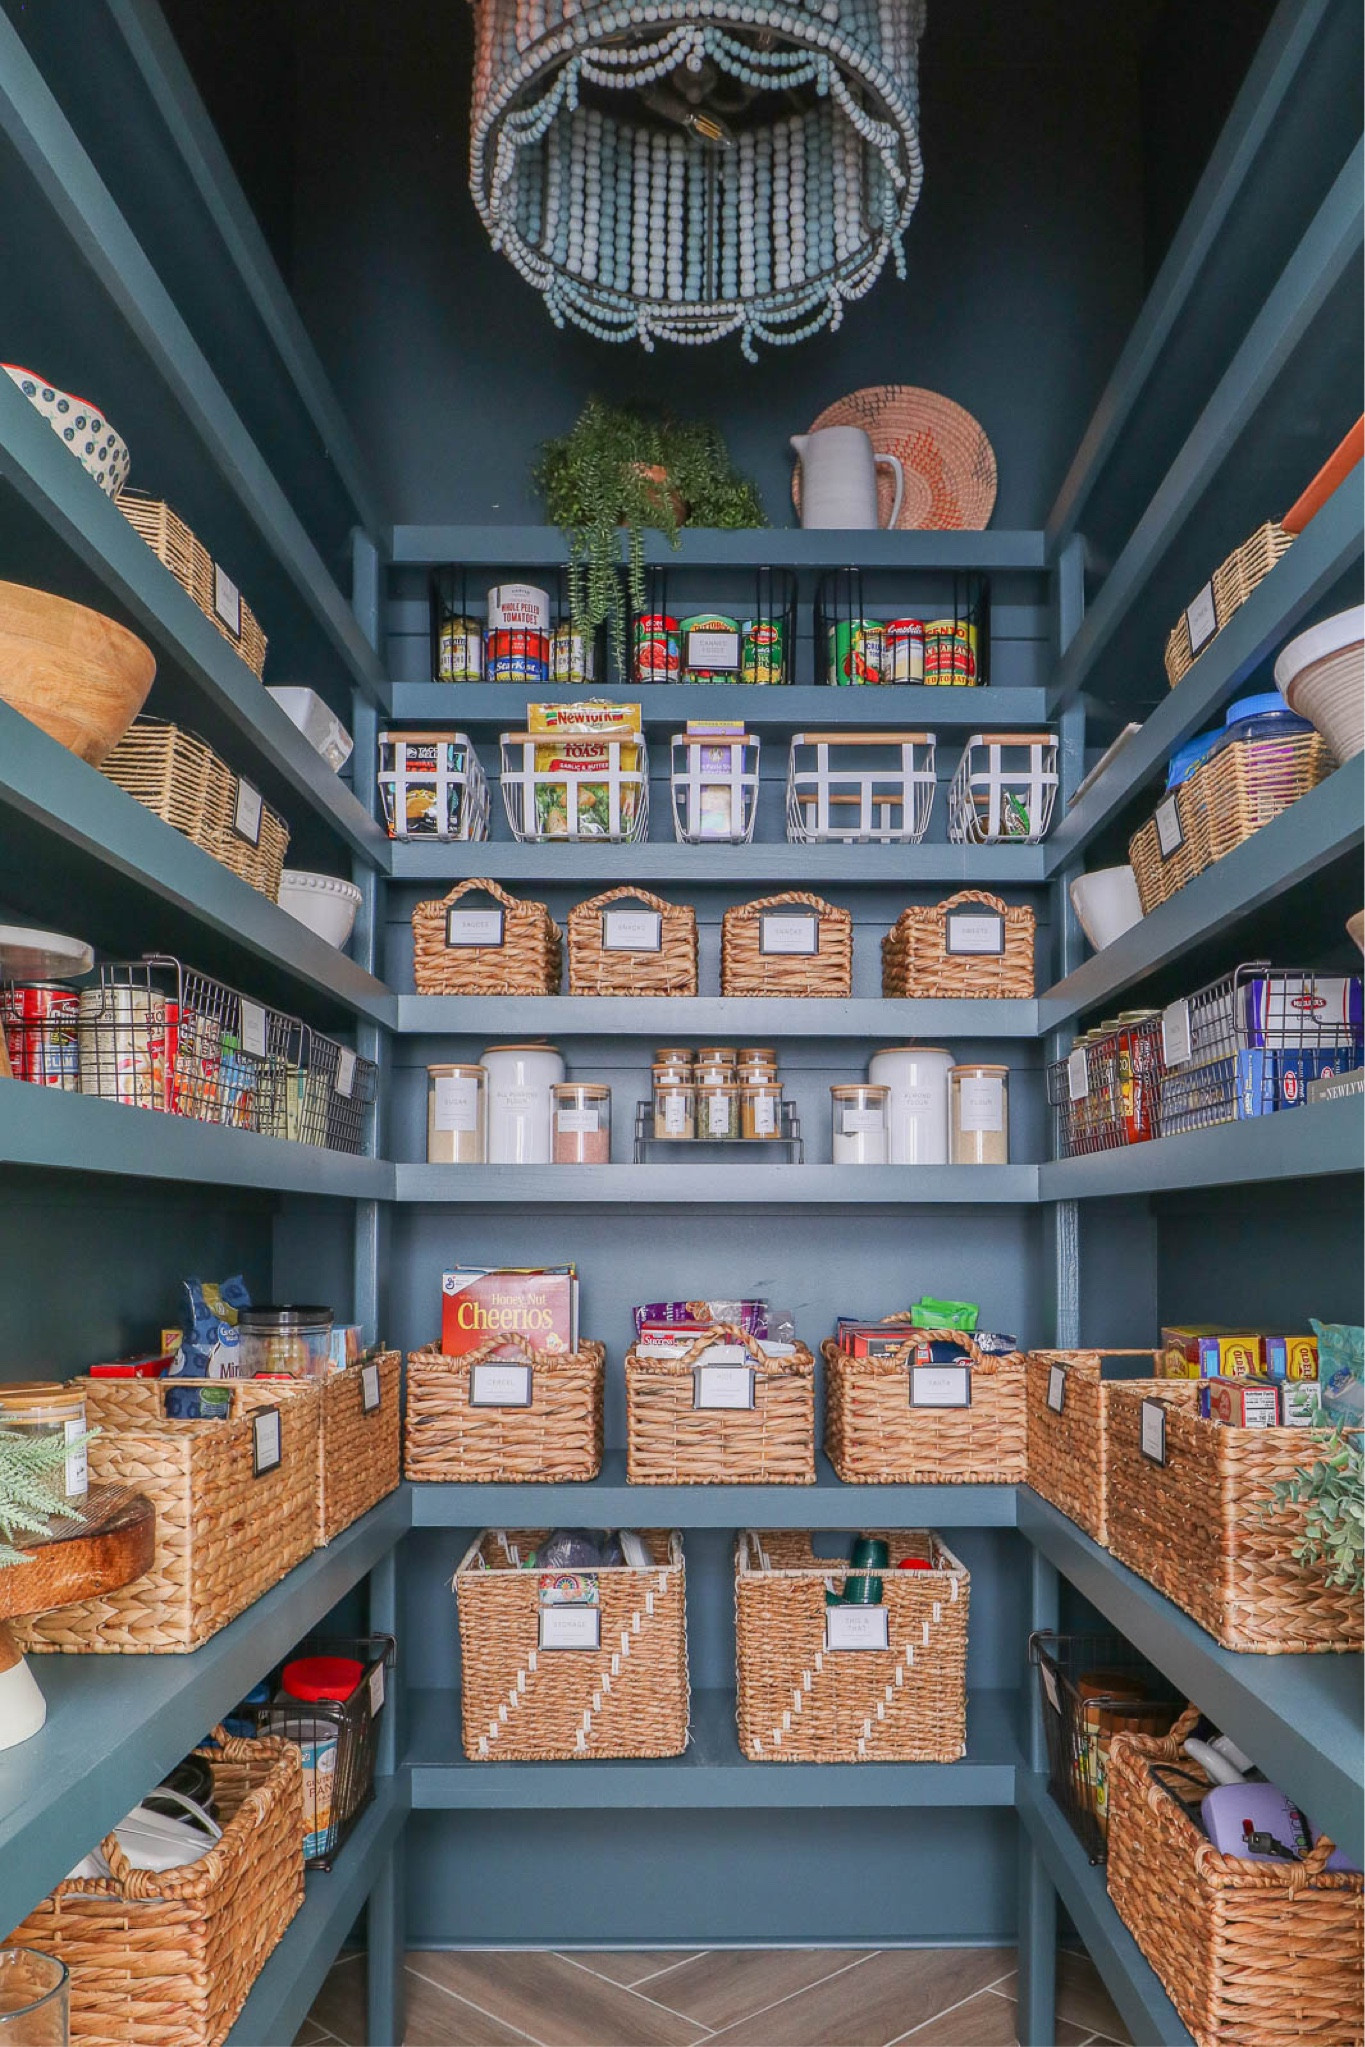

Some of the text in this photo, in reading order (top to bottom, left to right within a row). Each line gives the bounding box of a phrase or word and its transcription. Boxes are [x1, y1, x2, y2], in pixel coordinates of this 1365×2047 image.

[502, 602, 539, 615] WHOLE PEELED
[503, 613, 538, 625] TOMATOES
[563, 743, 605, 757] TOAST
[492, 1293, 546, 1307] Honey Nut
[457, 1301, 554, 1330] Cheerios
